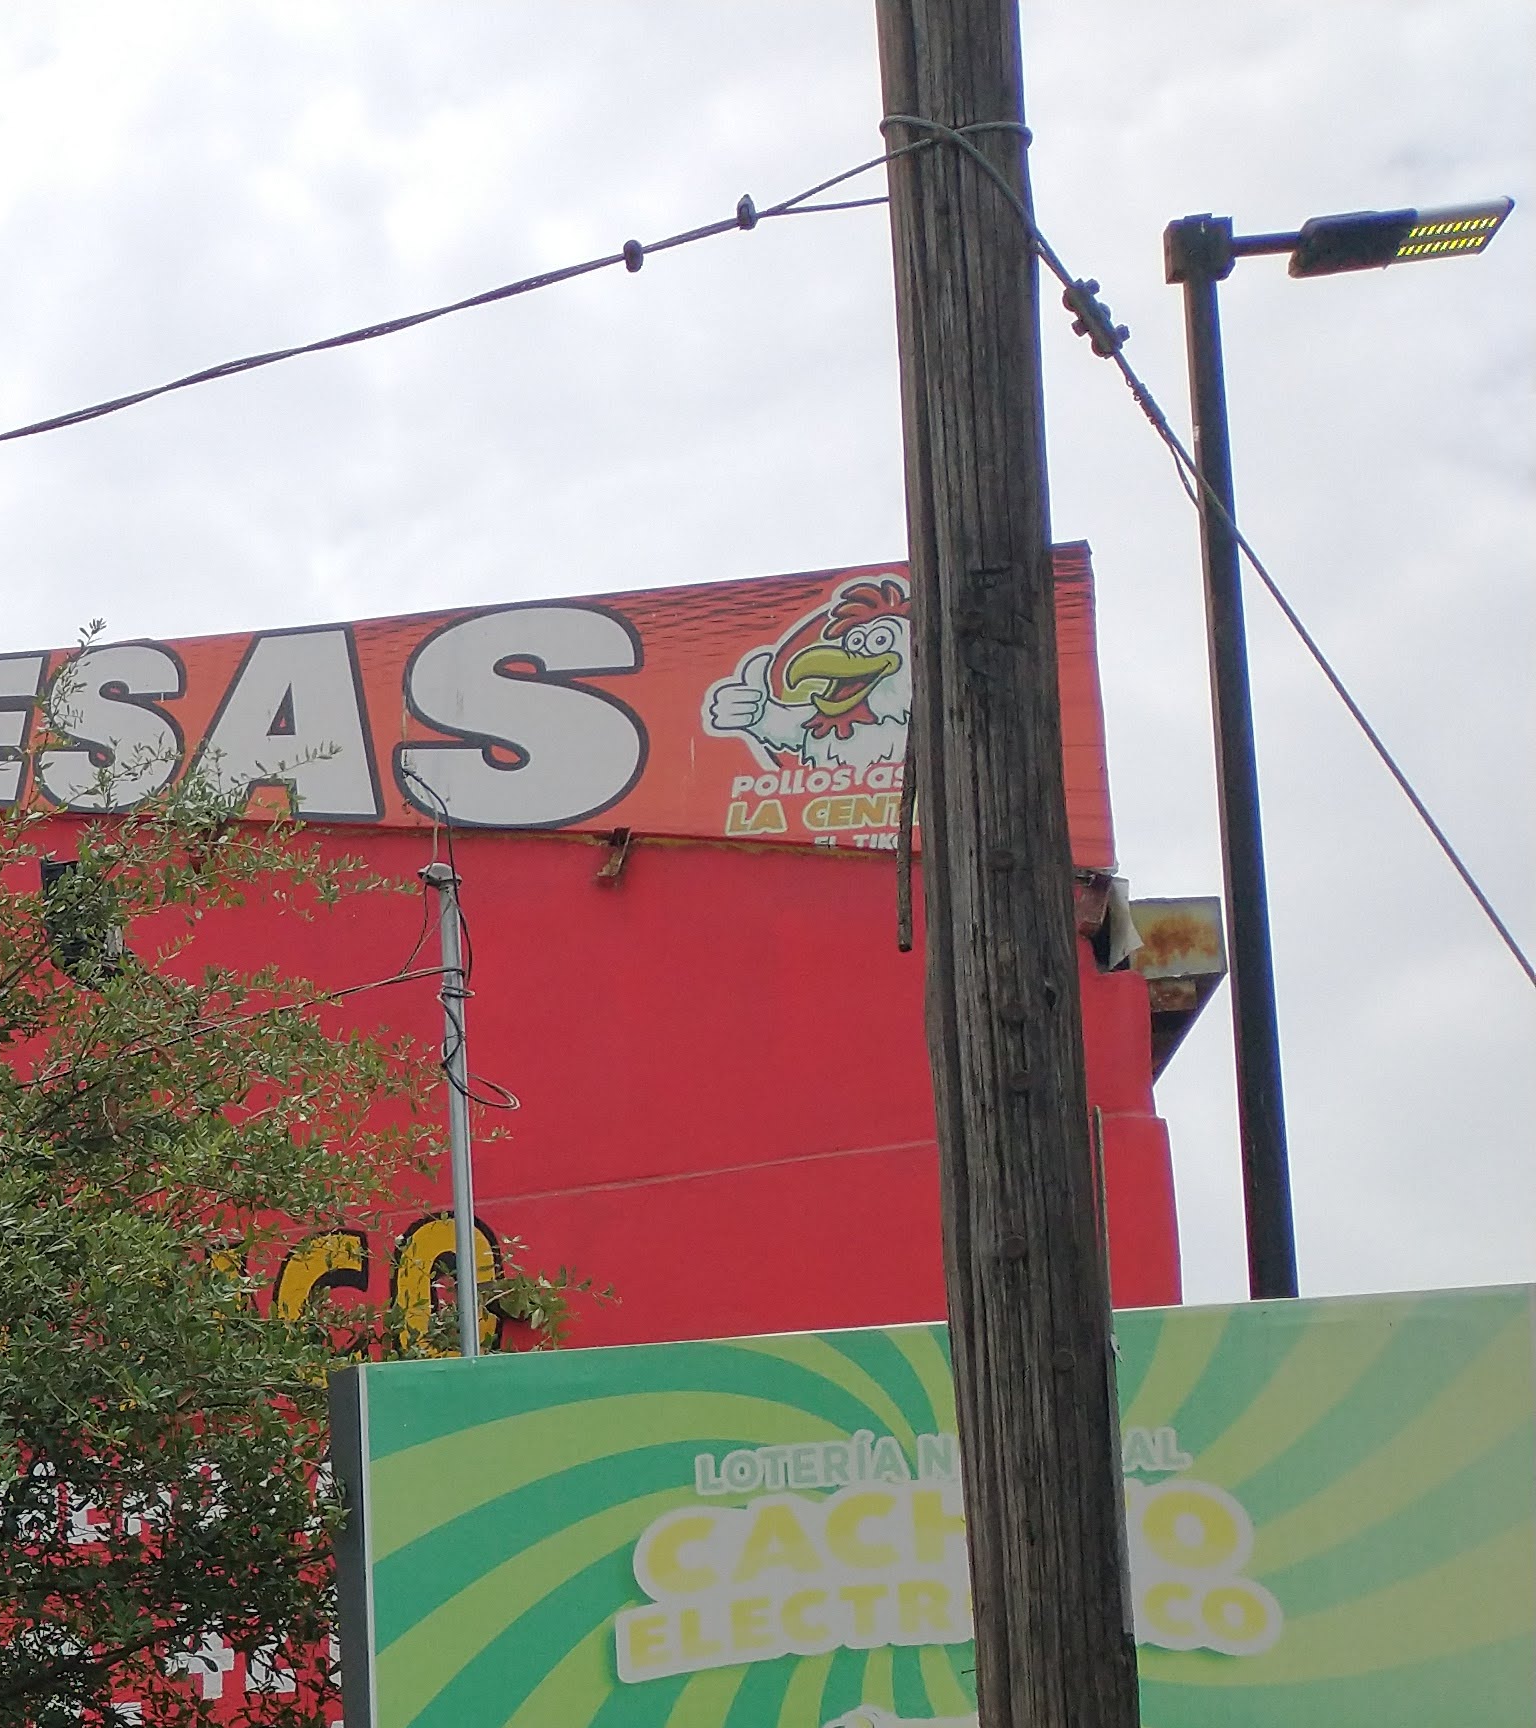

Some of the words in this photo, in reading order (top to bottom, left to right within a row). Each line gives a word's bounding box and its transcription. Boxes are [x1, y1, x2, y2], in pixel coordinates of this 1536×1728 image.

[725, 800, 788, 836] LA
[802, 793, 918, 830] CENT
[698, 1432, 911, 1491] LOTERÍA
[645, 1488, 1239, 1593] CACHO
[629, 1578, 1268, 1669] ELECTRCO
